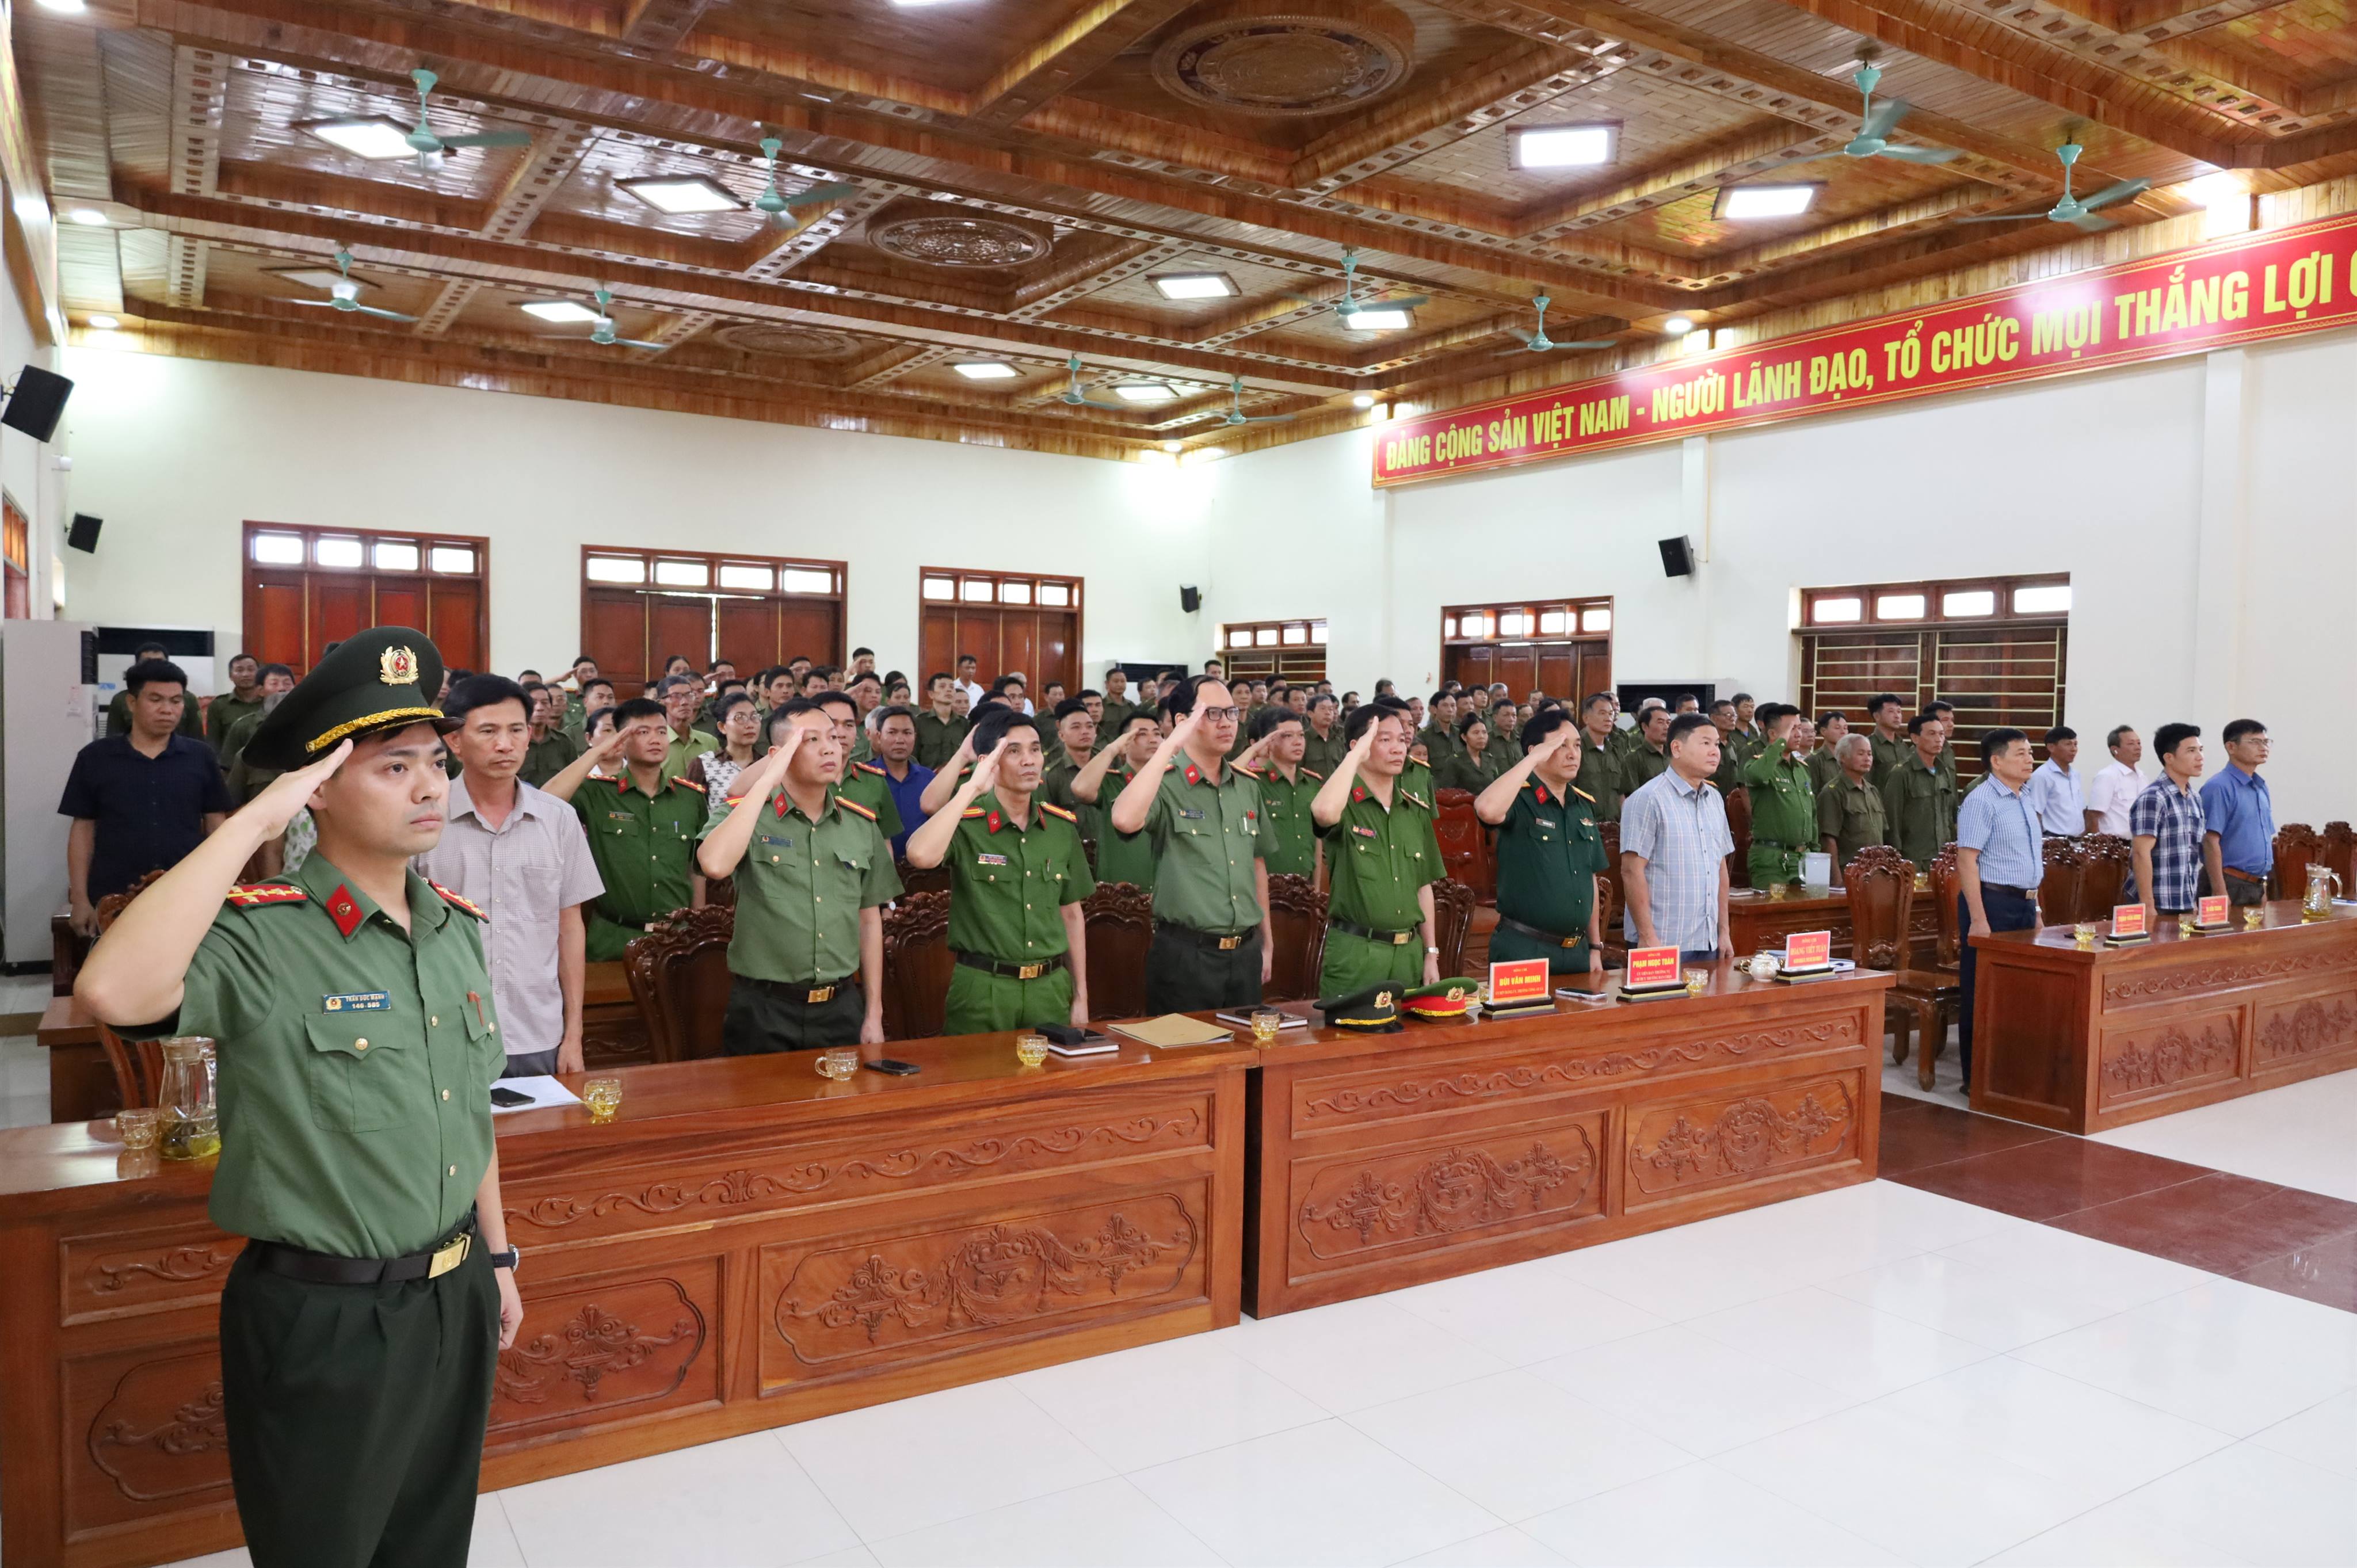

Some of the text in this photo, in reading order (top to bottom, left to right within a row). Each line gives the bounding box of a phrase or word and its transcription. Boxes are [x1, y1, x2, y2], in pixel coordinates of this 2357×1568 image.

[1386, 430, 1431, 471] ĐẢNG
[1436, 423, 1482, 467] CỘNG
[1488, 408, 1527, 452] SẢN
[1532, 402, 1574, 448] VIỆT
[1580, 395, 1630, 436] NAM
[1652, 368, 1726, 423] NGƯỜI
[1733, 360, 1802, 409] LÃNH
[1809, 348, 1874, 400] ĐẠO,
[1884, 320, 1923, 381] TỔ
[1931, 313, 2019, 373] CHỨC
[2031, 300, 2102, 358] MỌI
[2114, 264, 2249, 339] THẮNG
[2264, 250, 2333, 319] LỢI
